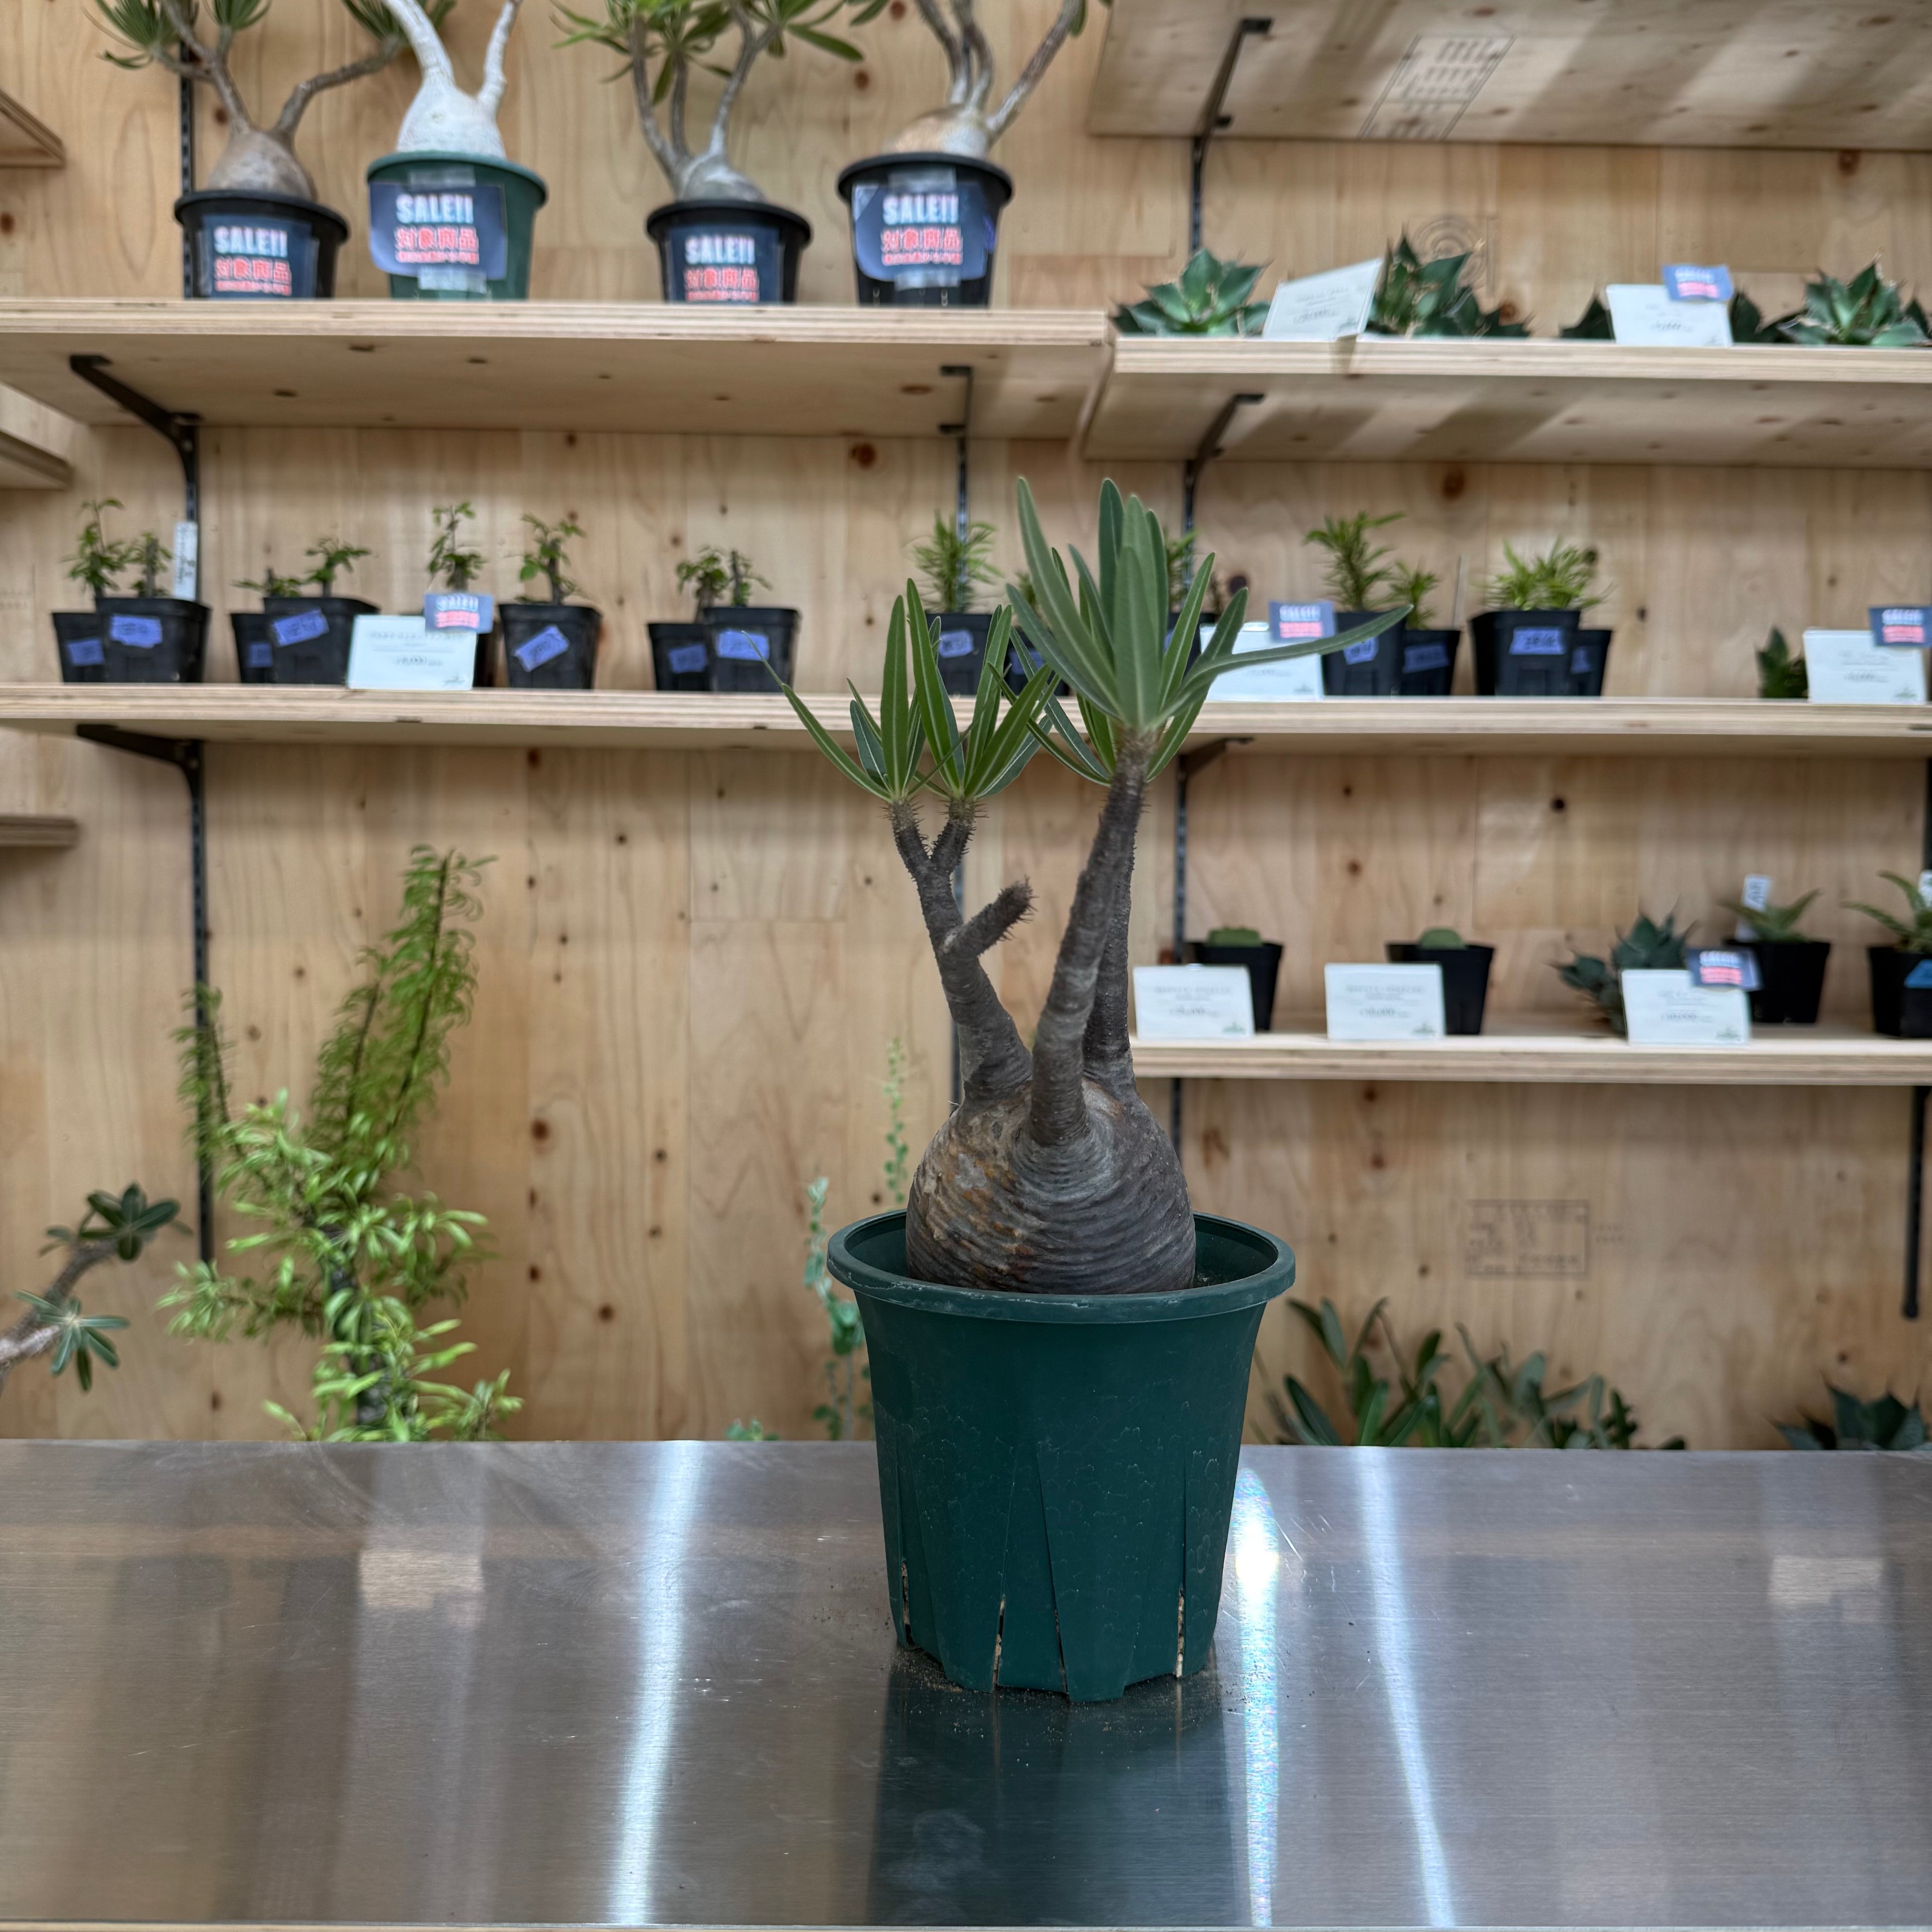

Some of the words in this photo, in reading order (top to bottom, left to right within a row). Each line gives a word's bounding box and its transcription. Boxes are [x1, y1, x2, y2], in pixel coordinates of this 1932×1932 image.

[395, 194, 474, 223] SALE!!
[883, 194, 958, 225] SALE!!
[214, 226, 287, 258] SALE!!
[685, 236, 755, 265] SALE!!
